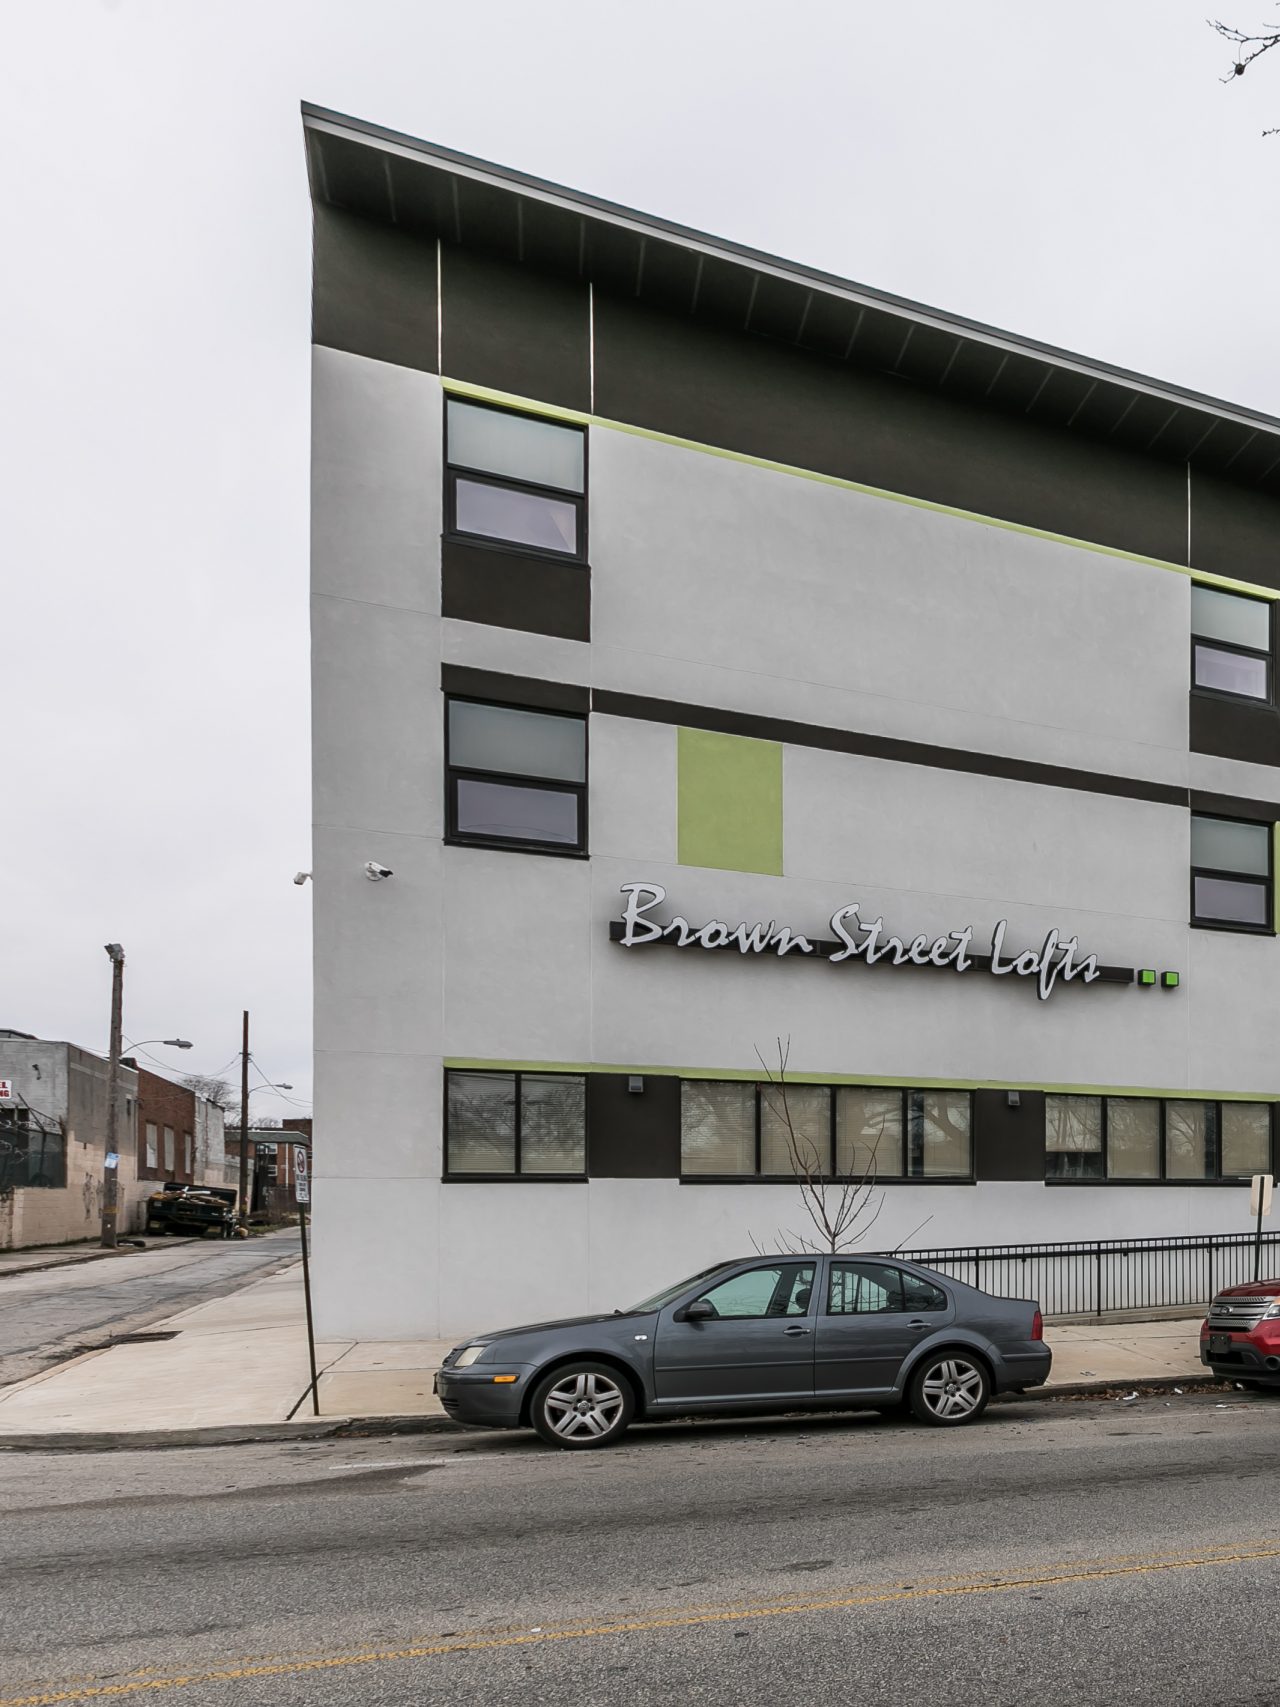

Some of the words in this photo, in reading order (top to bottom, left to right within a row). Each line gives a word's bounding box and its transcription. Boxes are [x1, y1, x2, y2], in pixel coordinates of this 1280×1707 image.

[619, 881, 814, 956] Brown
[828, 902, 974, 972] Street
[989, 919, 1100, 1000] Lofts
